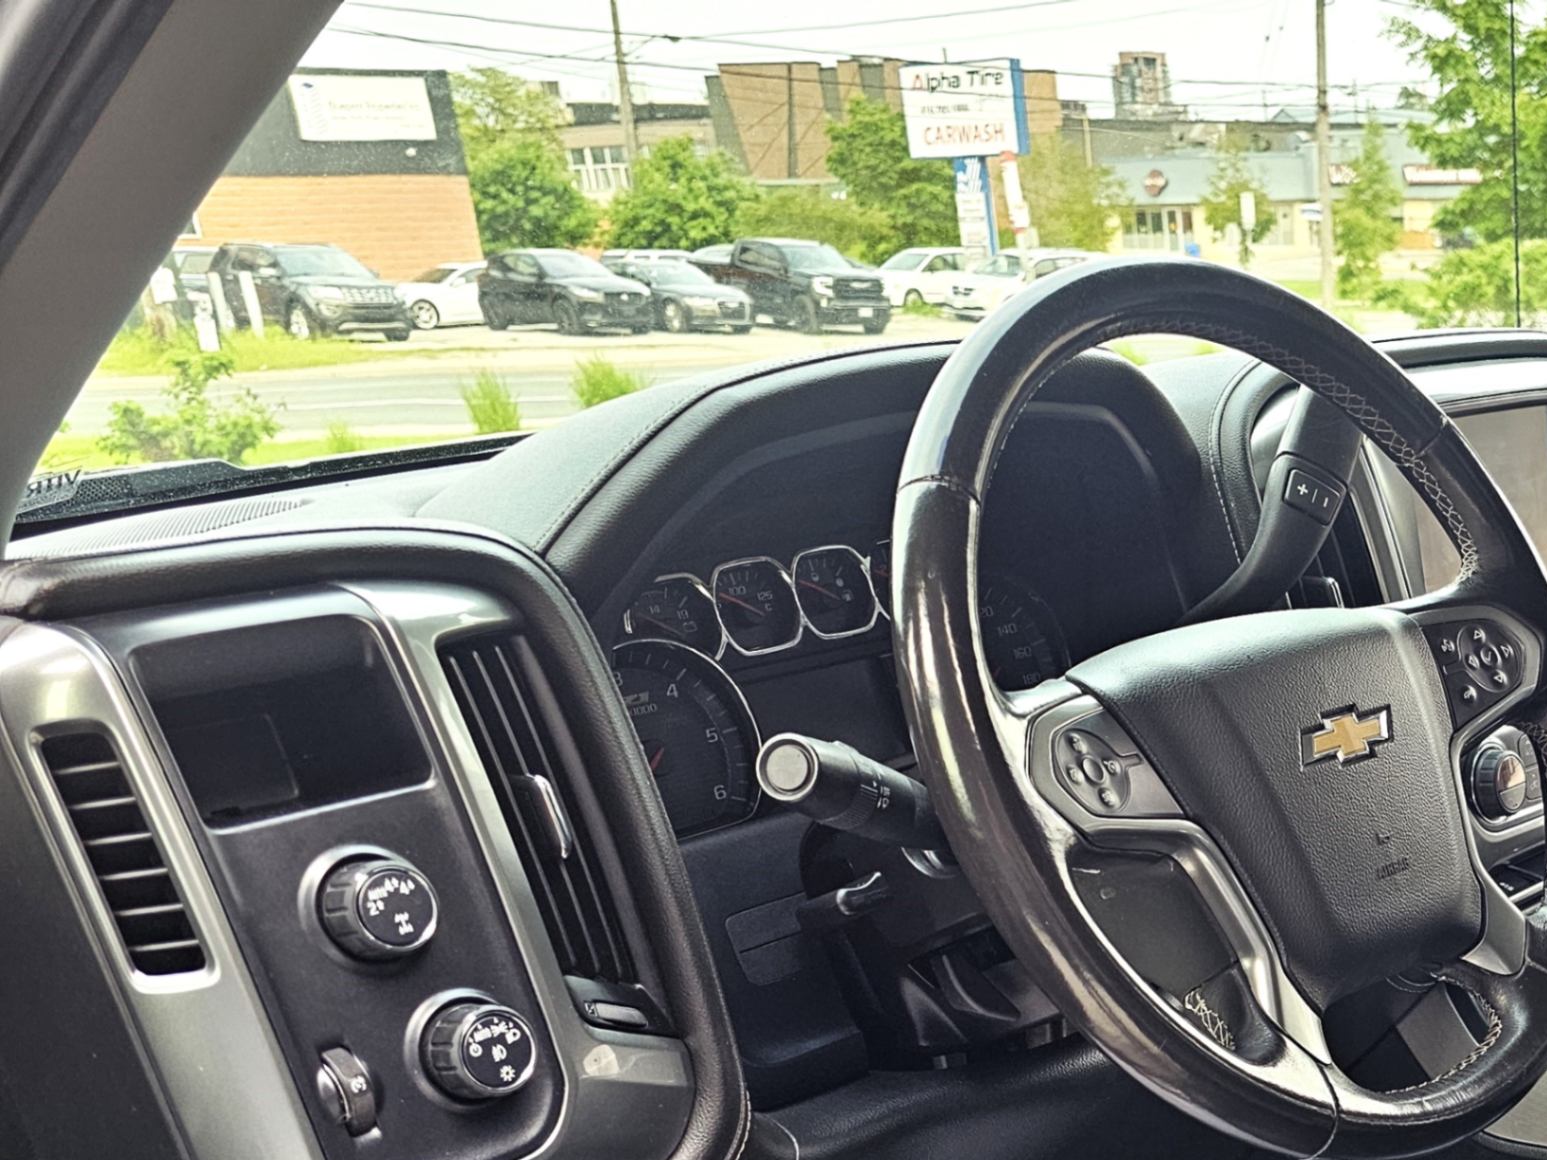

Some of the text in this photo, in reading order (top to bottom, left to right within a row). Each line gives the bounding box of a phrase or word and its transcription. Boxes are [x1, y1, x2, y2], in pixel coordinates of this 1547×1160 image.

[912, 70, 1004, 92] Alpha Tire
[923, 122, 1006, 146] CARWASH
[728, 585, 747, 596] 100
[756, 590, 774, 602] 125
[676, 608, 689, 621] 19
[666, 683, 679, 698] 4
[705, 728, 718, 743] 5
[713, 784, 727, 800] 6
